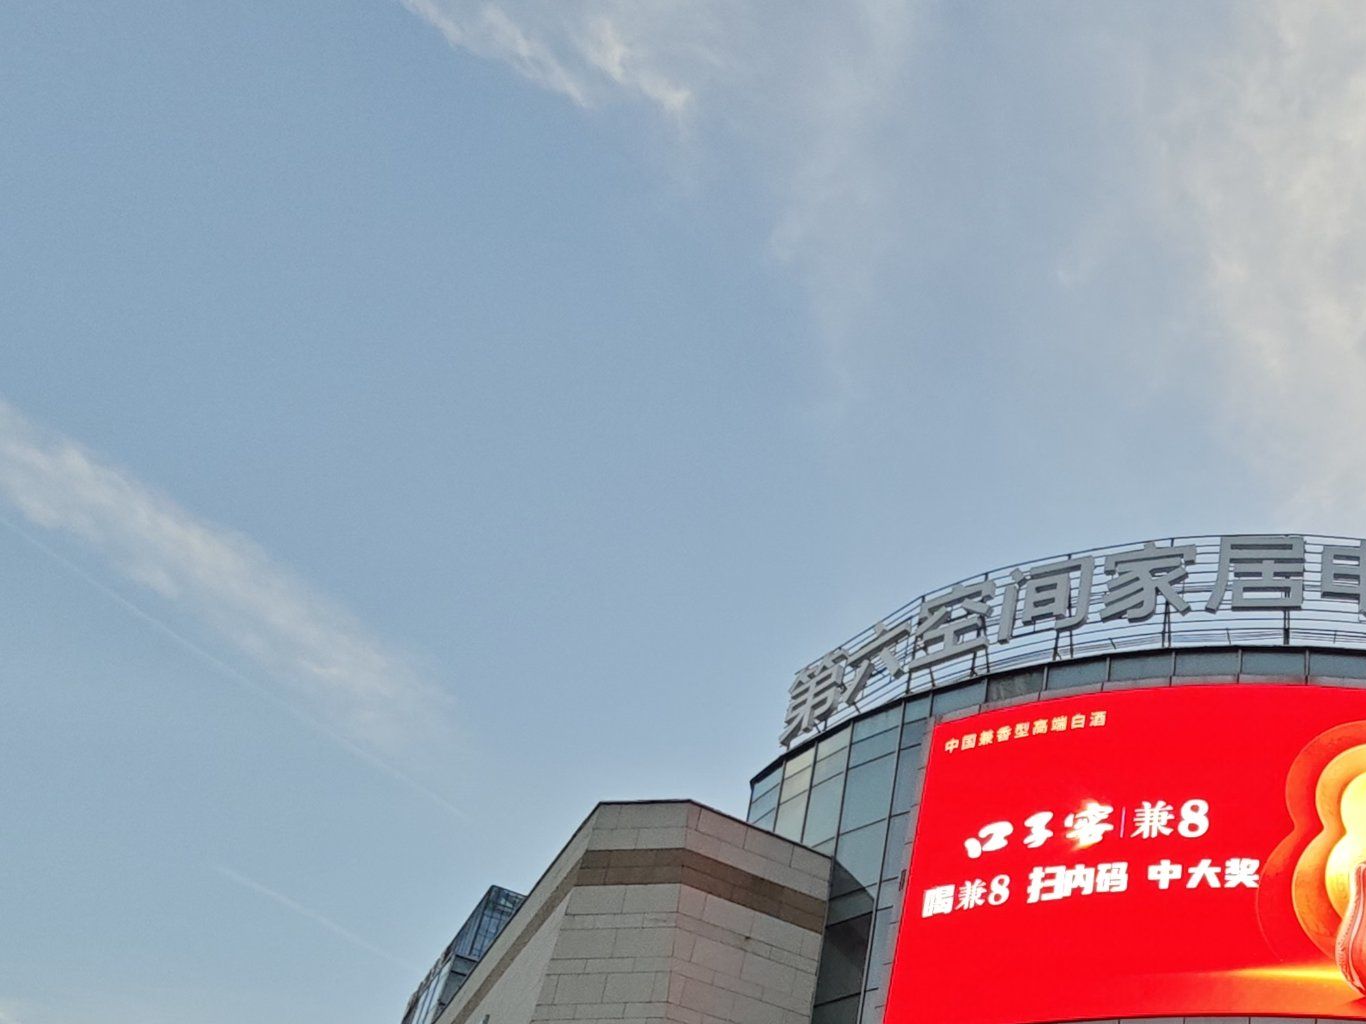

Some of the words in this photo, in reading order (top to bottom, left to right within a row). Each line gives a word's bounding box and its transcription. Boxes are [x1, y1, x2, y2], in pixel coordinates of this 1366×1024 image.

[944, 710, 1107, 753] 中国兼香型高端白酒
[1130, 799, 1210, 839] 兼8
[1026, 861, 1129, 904] 扫内码
[1147, 858, 1260, 890] 中大奖
